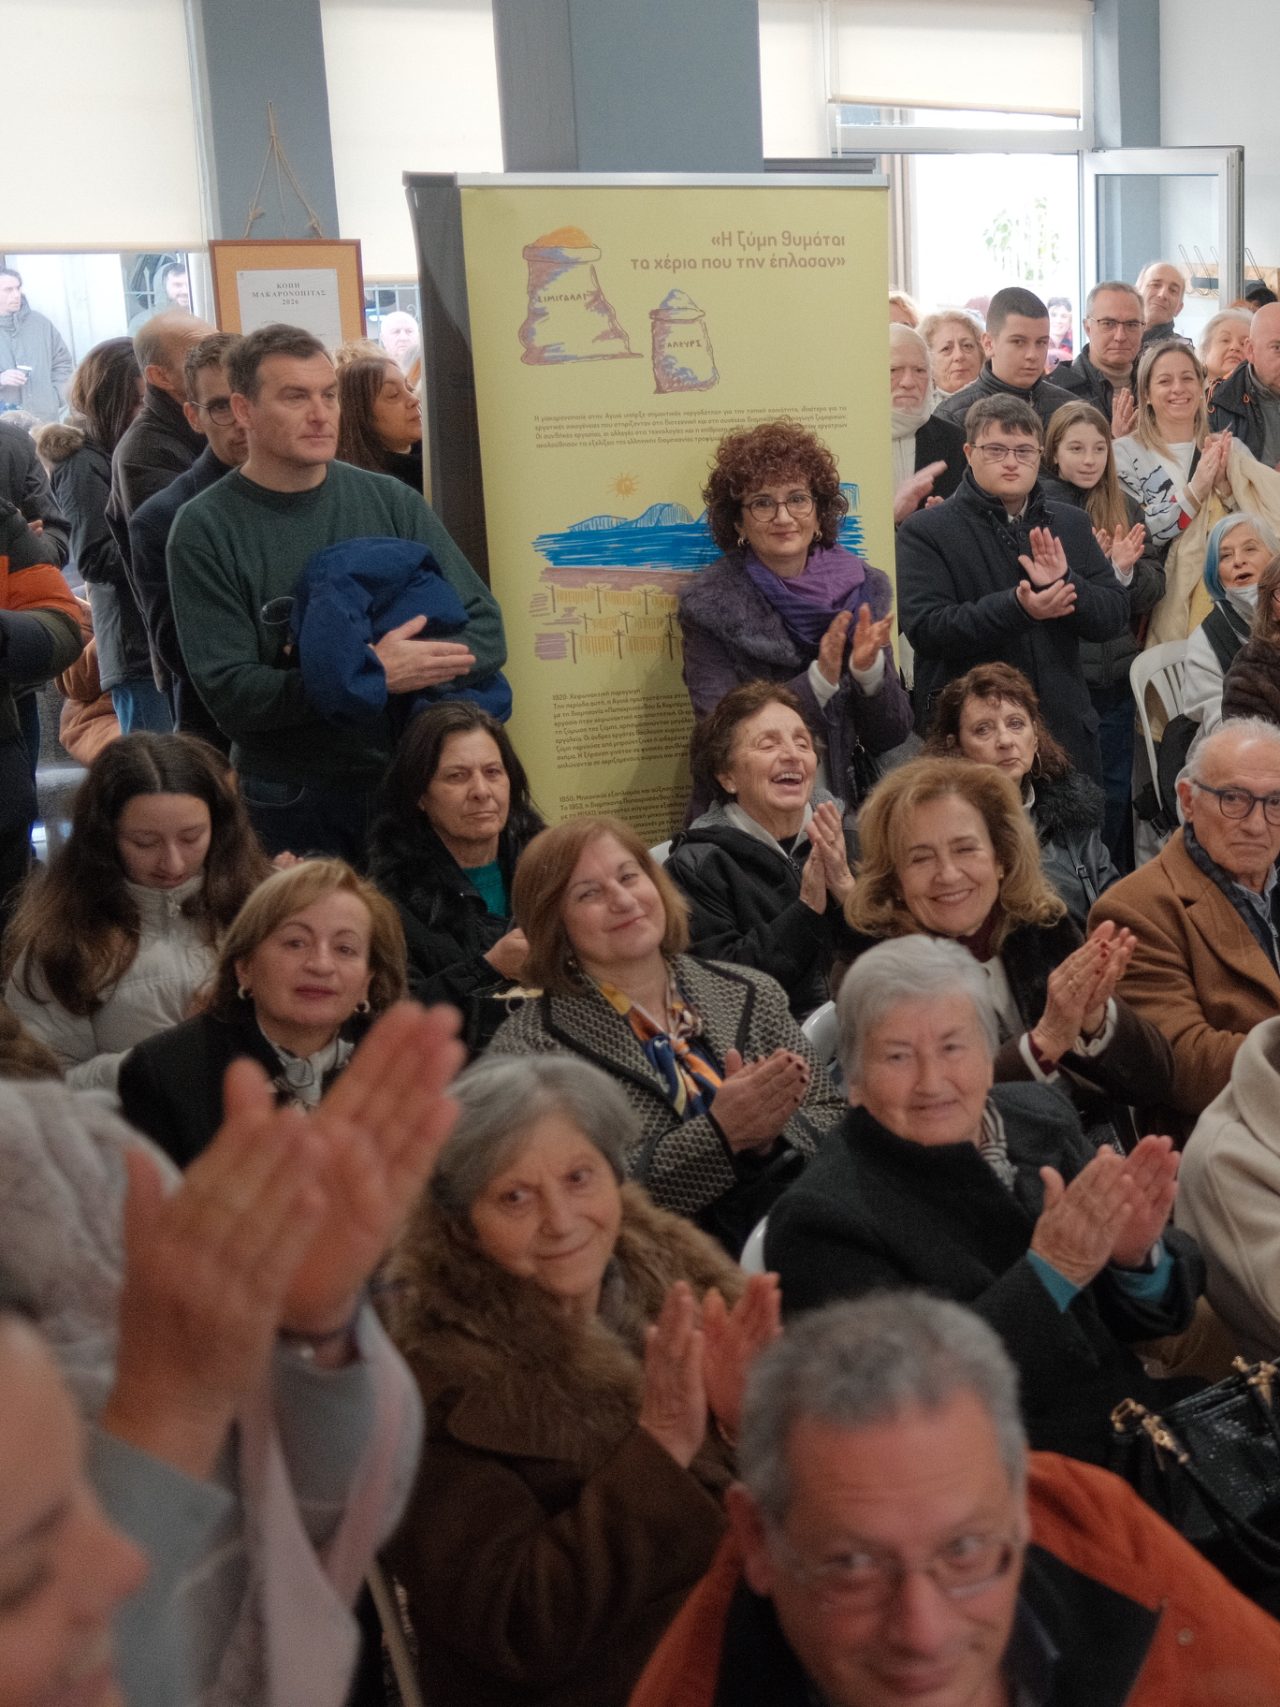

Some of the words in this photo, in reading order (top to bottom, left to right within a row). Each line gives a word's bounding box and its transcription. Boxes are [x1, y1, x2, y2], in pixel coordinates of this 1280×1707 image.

[737, 231, 777, 251] ζύμη
[781, 230, 845, 251] θυμάται
[630, 257, 650, 270] τα
[654, 253, 697, 274] χέρια
[702, 256, 732, 270] που
[737, 255, 766, 269] την
[769, 252, 846, 269] έπλασαν»
[252, 289, 327, 298] ΜΑΚΑΡΟΝΟΠΙΤΑΣ
